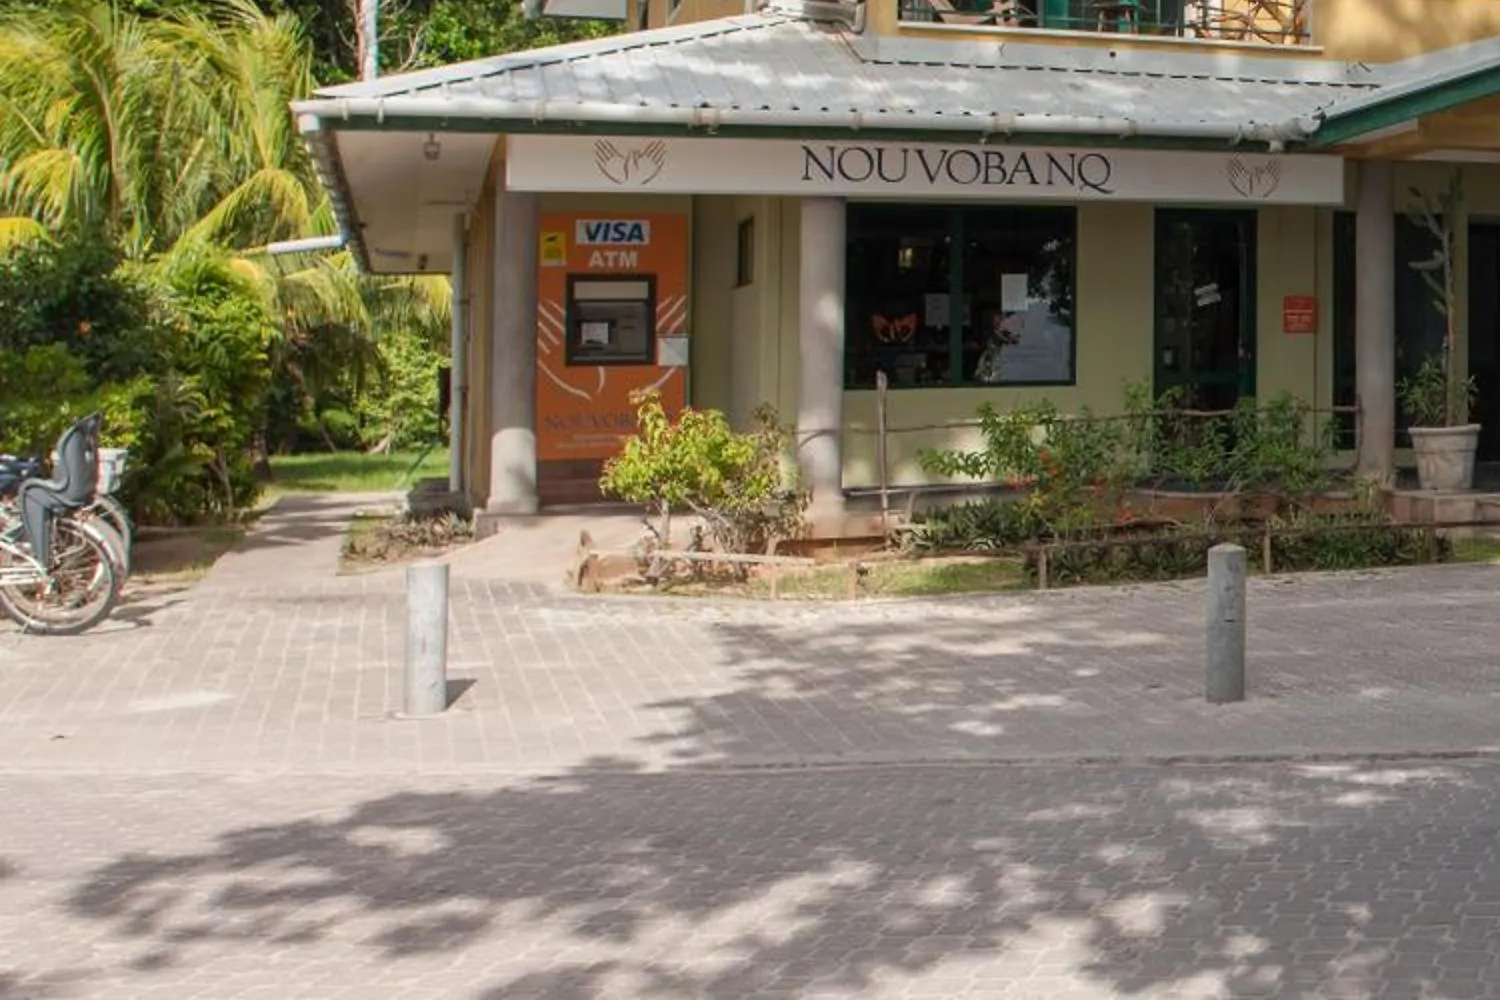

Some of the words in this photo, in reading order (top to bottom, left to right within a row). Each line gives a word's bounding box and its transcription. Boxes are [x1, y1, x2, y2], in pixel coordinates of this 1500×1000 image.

[800, 145, 1114, 194] NOUVOBANQ
[585, 222, 645, 242] VISA
[588, 250, 638, 268] ATM
